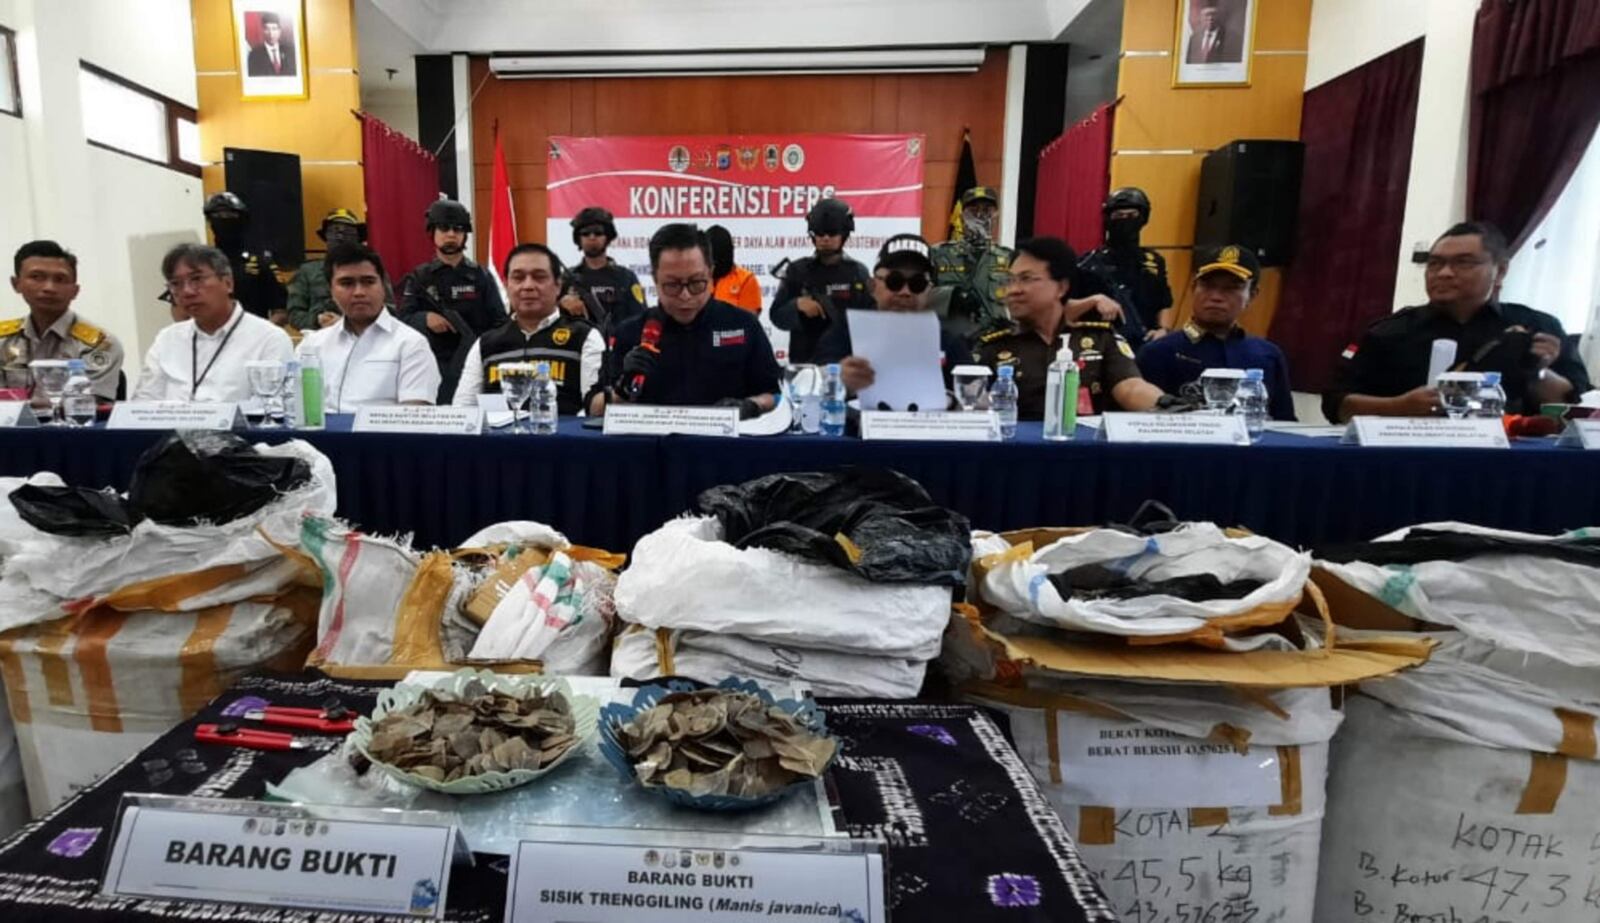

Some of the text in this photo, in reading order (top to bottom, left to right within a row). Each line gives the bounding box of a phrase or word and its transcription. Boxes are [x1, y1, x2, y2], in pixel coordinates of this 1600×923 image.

[629, 186, 772, 216] KONFERENSI
[1099, 729, 1140, 740] BERAT
[1087, 746, 1129, 757] BERAT
[1133, 746, 1182, 756] BERSIH
[1451, 812, 1564, 860] KOTAK
[165, 840, 397, 880] BARANG BUKTI
[627, 871, 755, 890] BARANG BUKTI
[1112, 856, 1203, 897] 45,5
[1217, 849, 1252, 902] kg
[539, 889, 844, 919] SISIK TRENGGILING (Manis javanica)
